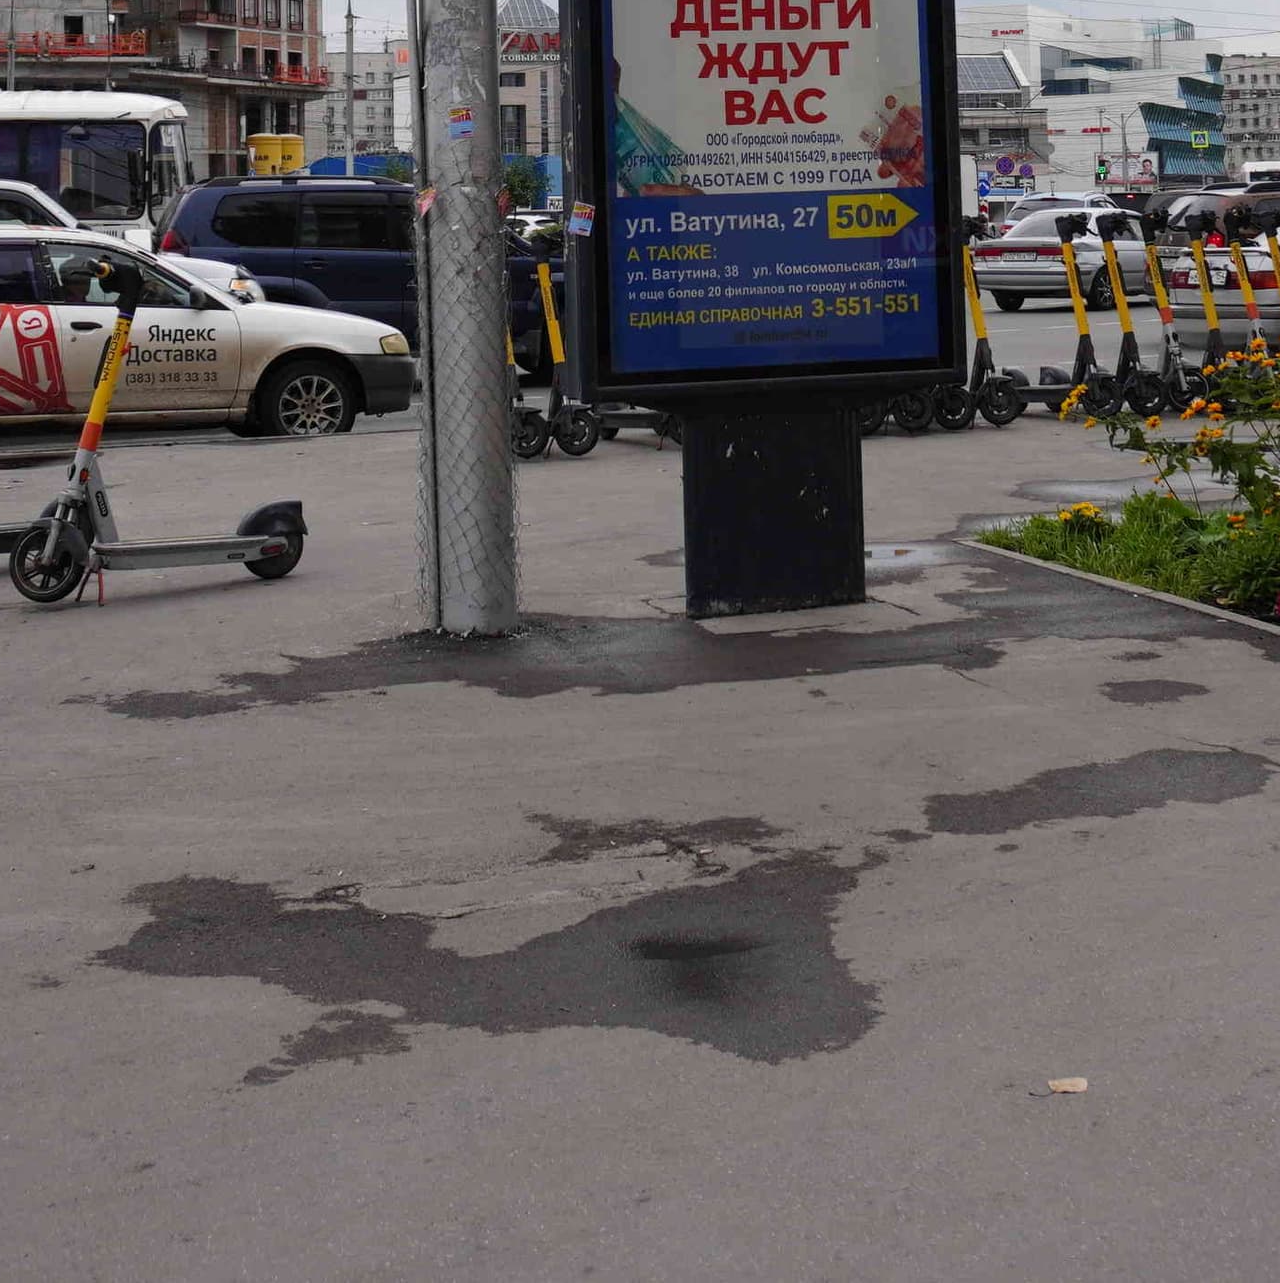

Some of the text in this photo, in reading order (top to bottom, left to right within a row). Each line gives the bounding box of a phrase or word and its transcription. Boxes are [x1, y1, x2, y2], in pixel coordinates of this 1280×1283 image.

[697, 41, 850, 85] ЖДУТ
[724, 88, 829, 126] ВАС
[706, 133, 729, 146] ООО
[731, 131, 789, 148] «Городской
[625, 155, 655, 169] ОГРН
[741, 153, 763, 165] ИНН
[765, 150, 830, 166] 5404156429,
[831, 153, 838, 161] в
[681, 168, 872, 188] РАБОТАЕМ С 1999 ГОДА
[626, 207, 819, 238] ул. Ватутина, 27
[836, 204, 898, 229] 50м
[627, 244, 718, 261] А ТАКЖЕ:
[627, 265, 739, 283] ул. Ватутина, 38
[752, 256, 917, 278] ул. Комсомольская, 23а/1
[628, 277, 908, 302] и еще более 20 филиалов по городу и области.
[629, 294, 921, 329] ЕДИНАЯ СПРАВОЧНАЯ 3-551-551
[148, 324, 216, 344] Яндекс
[126, 345, 217, 366] Доставка
[125, 372, 218, 386] (383) 318 33 33
